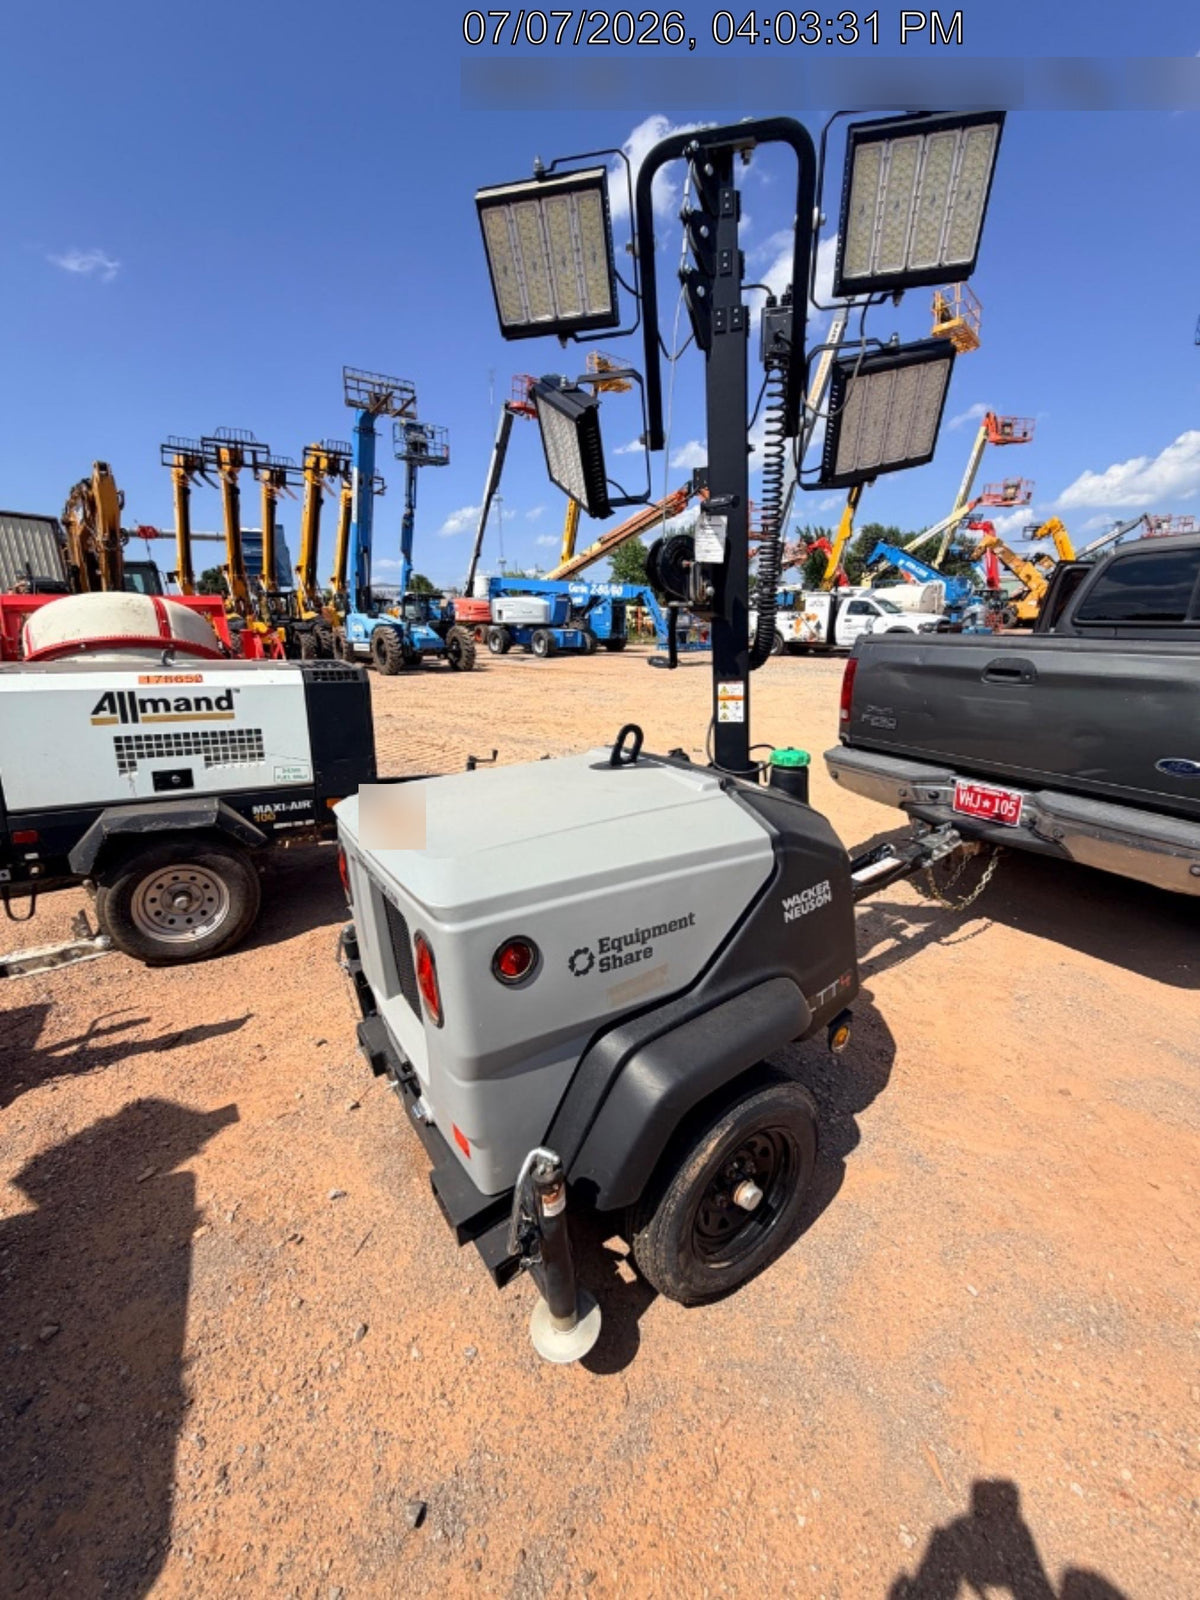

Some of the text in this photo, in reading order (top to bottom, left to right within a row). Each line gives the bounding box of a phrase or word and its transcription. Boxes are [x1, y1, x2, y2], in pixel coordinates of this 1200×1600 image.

[91, 688, 234, 724] Allmand
[252, 800, 312, 815] MAXI-AIR
[959, 789, 981, 808] VHJ
[992, 797, 1016, 817] 105
[782, 879, 830, 911] WACKER
[783, 890, 832, 924] NEUSON
[598, 911, 696, 955] Equipment
[598, 946, 653, 973] Share
